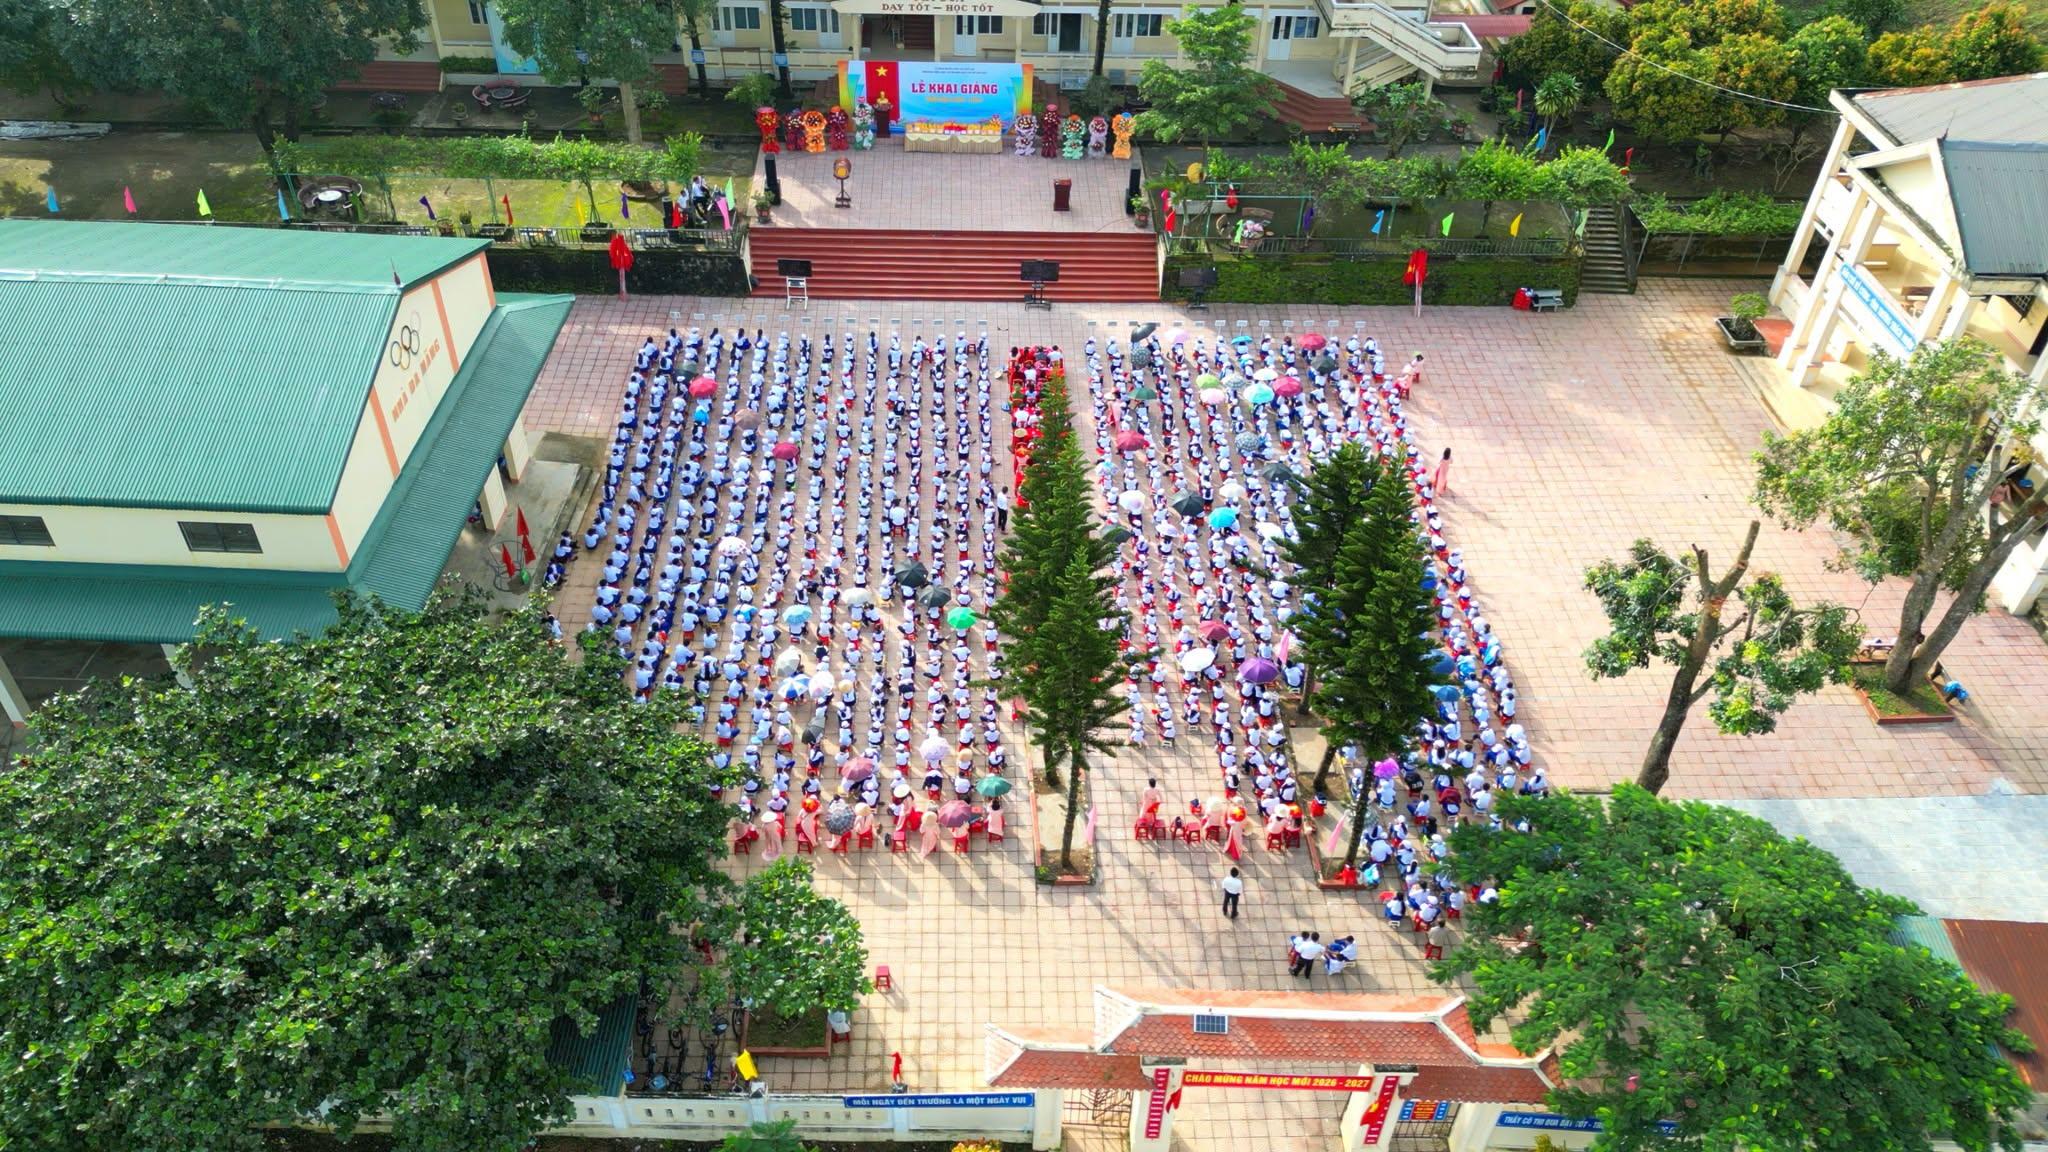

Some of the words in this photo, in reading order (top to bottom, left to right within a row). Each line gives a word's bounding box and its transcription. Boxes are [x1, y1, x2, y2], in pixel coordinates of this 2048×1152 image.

[882, 3, 904, 12] DẠY
[945, 4, 968, 13] HỌC
[928, 83, 957, 94] KHAI
[1185, 1073, 1212, 1083] CHÀO
[1244, 1074, 1268, 1084] NĂM
[1270, 1076, 1289, 1086] HỌC
[1312, 1078, 1337, 1087] 2026
[1344, 1079, 1370, 1087] 2027
[872, 1097, 895, 1106] NGÀY
[987, 1096, 1009, 1104] NGÀY
